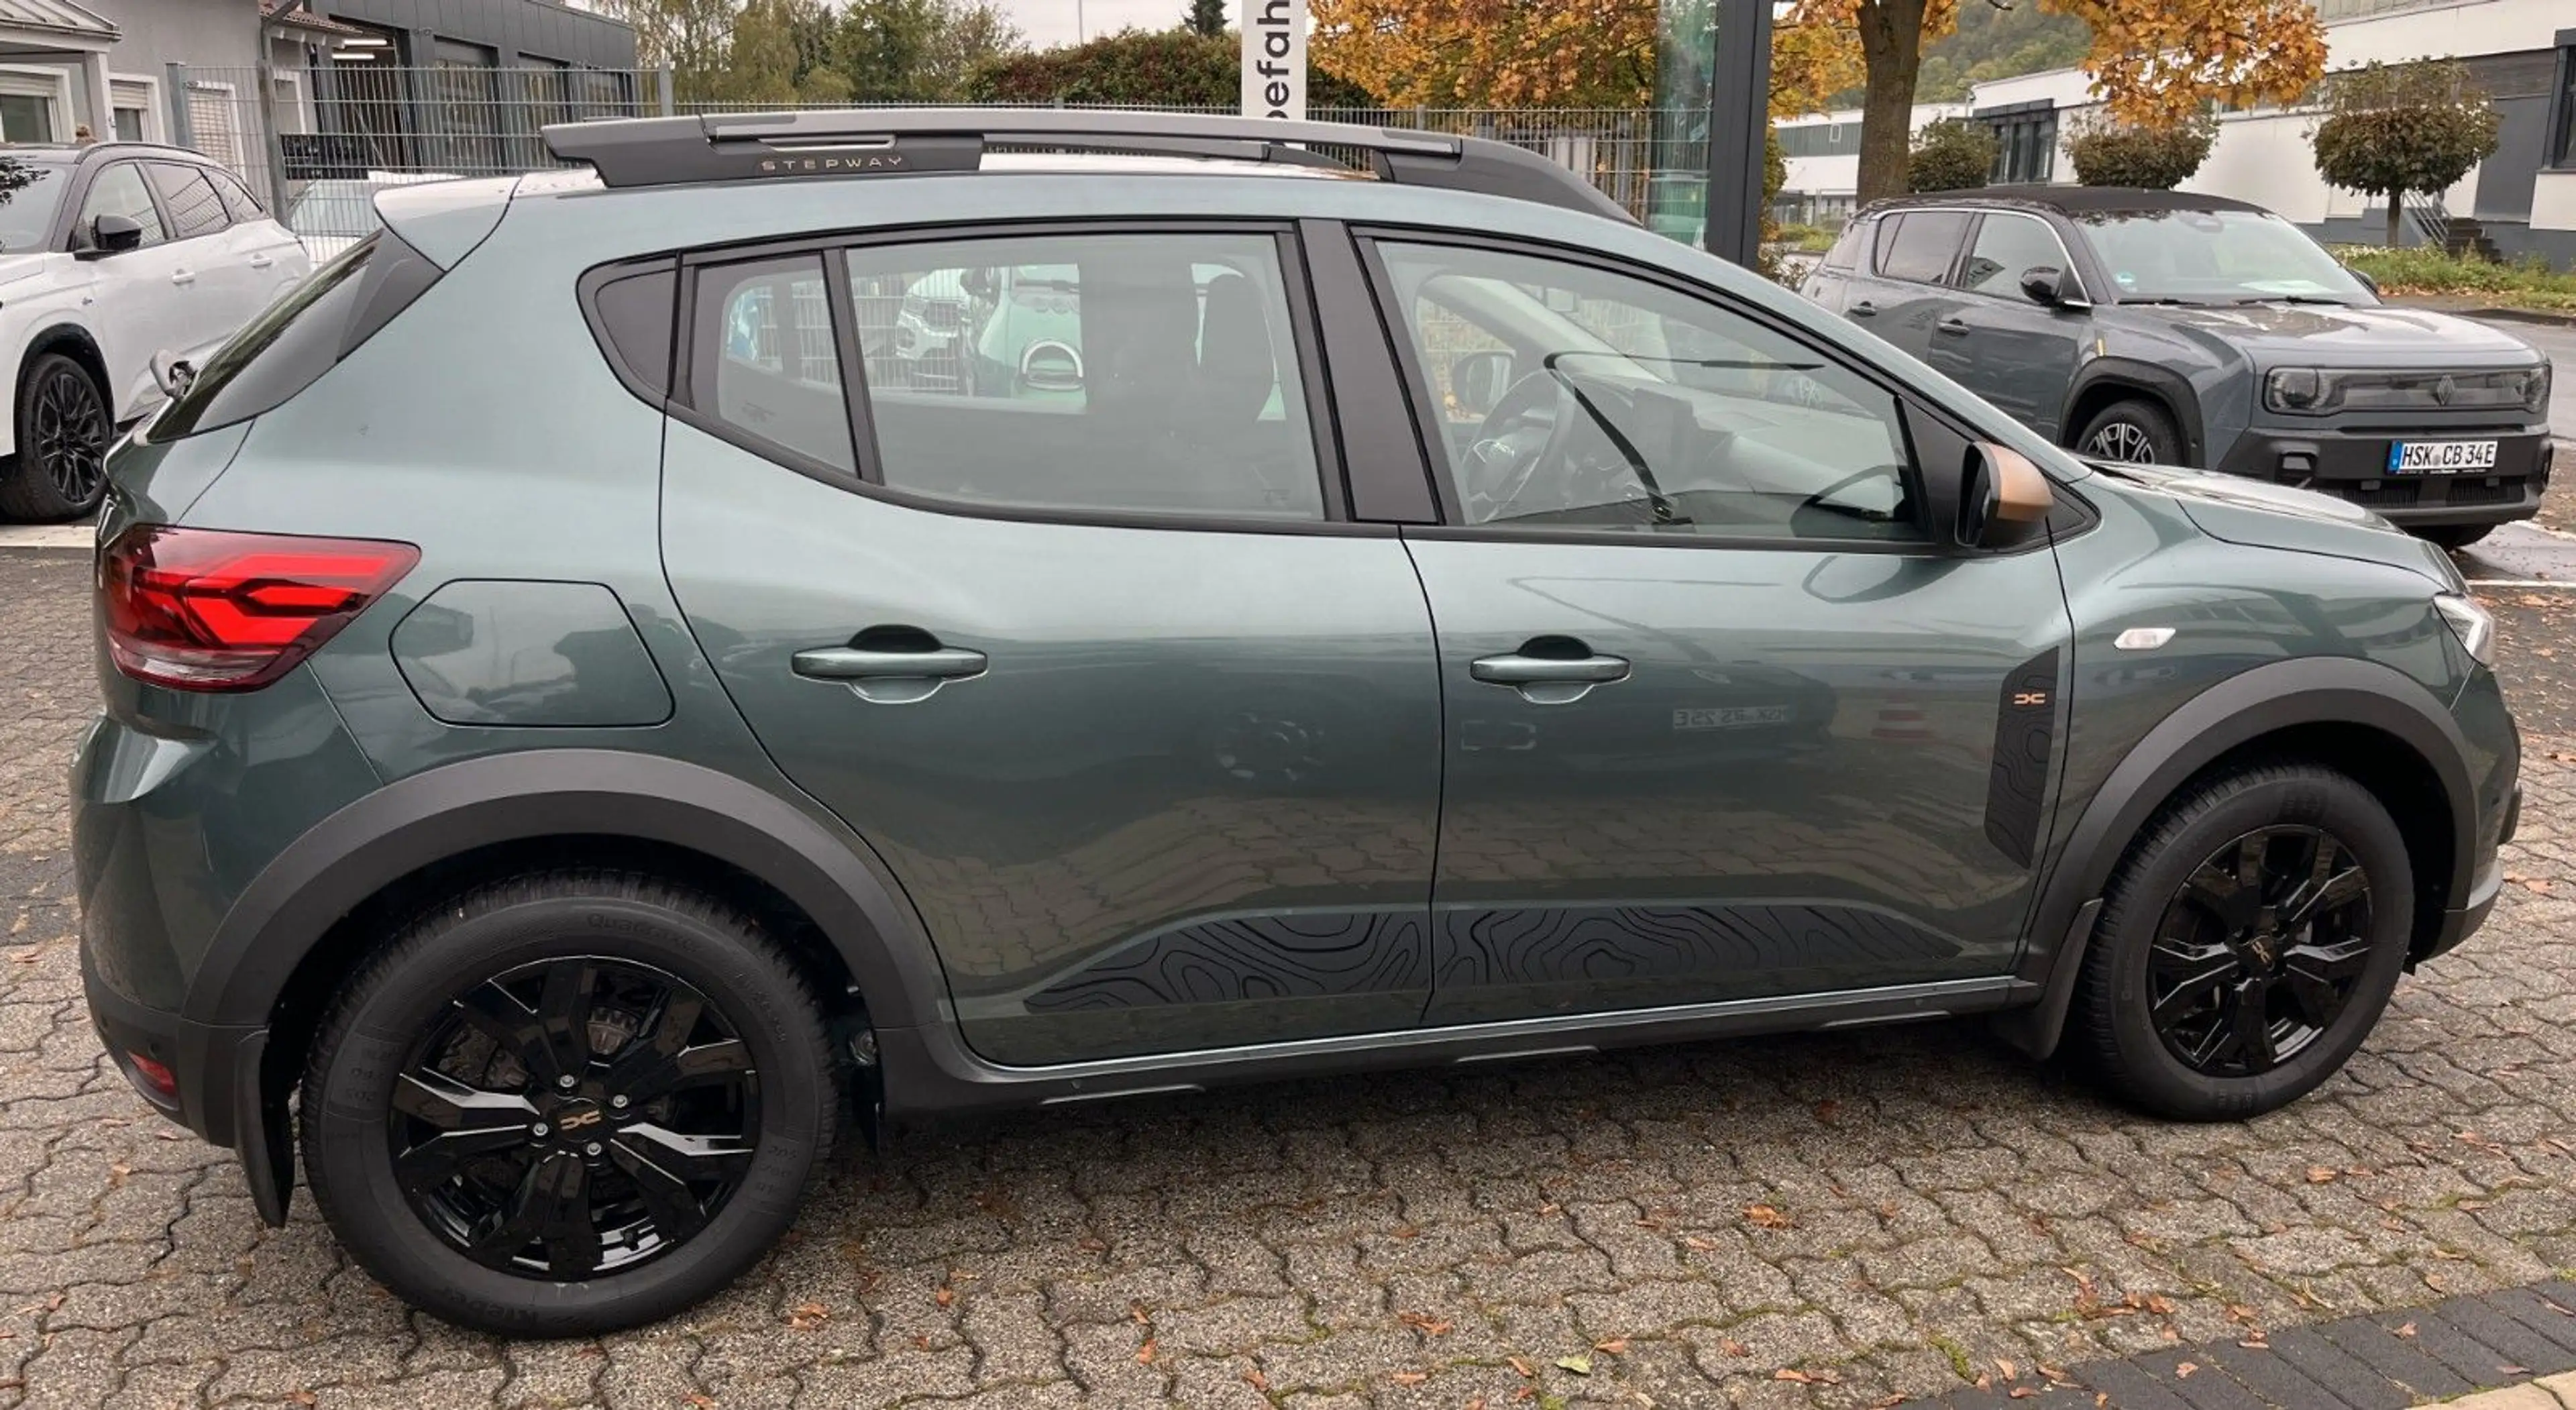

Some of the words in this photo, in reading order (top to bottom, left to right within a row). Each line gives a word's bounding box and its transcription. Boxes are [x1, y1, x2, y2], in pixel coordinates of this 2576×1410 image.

[761, 157, 902, 171] STEPWAY
[2402, 445, 2434, 466] HSK
[2442, 445, 2463, 465] CB
[2465, 443, 2495, 464] 34E
